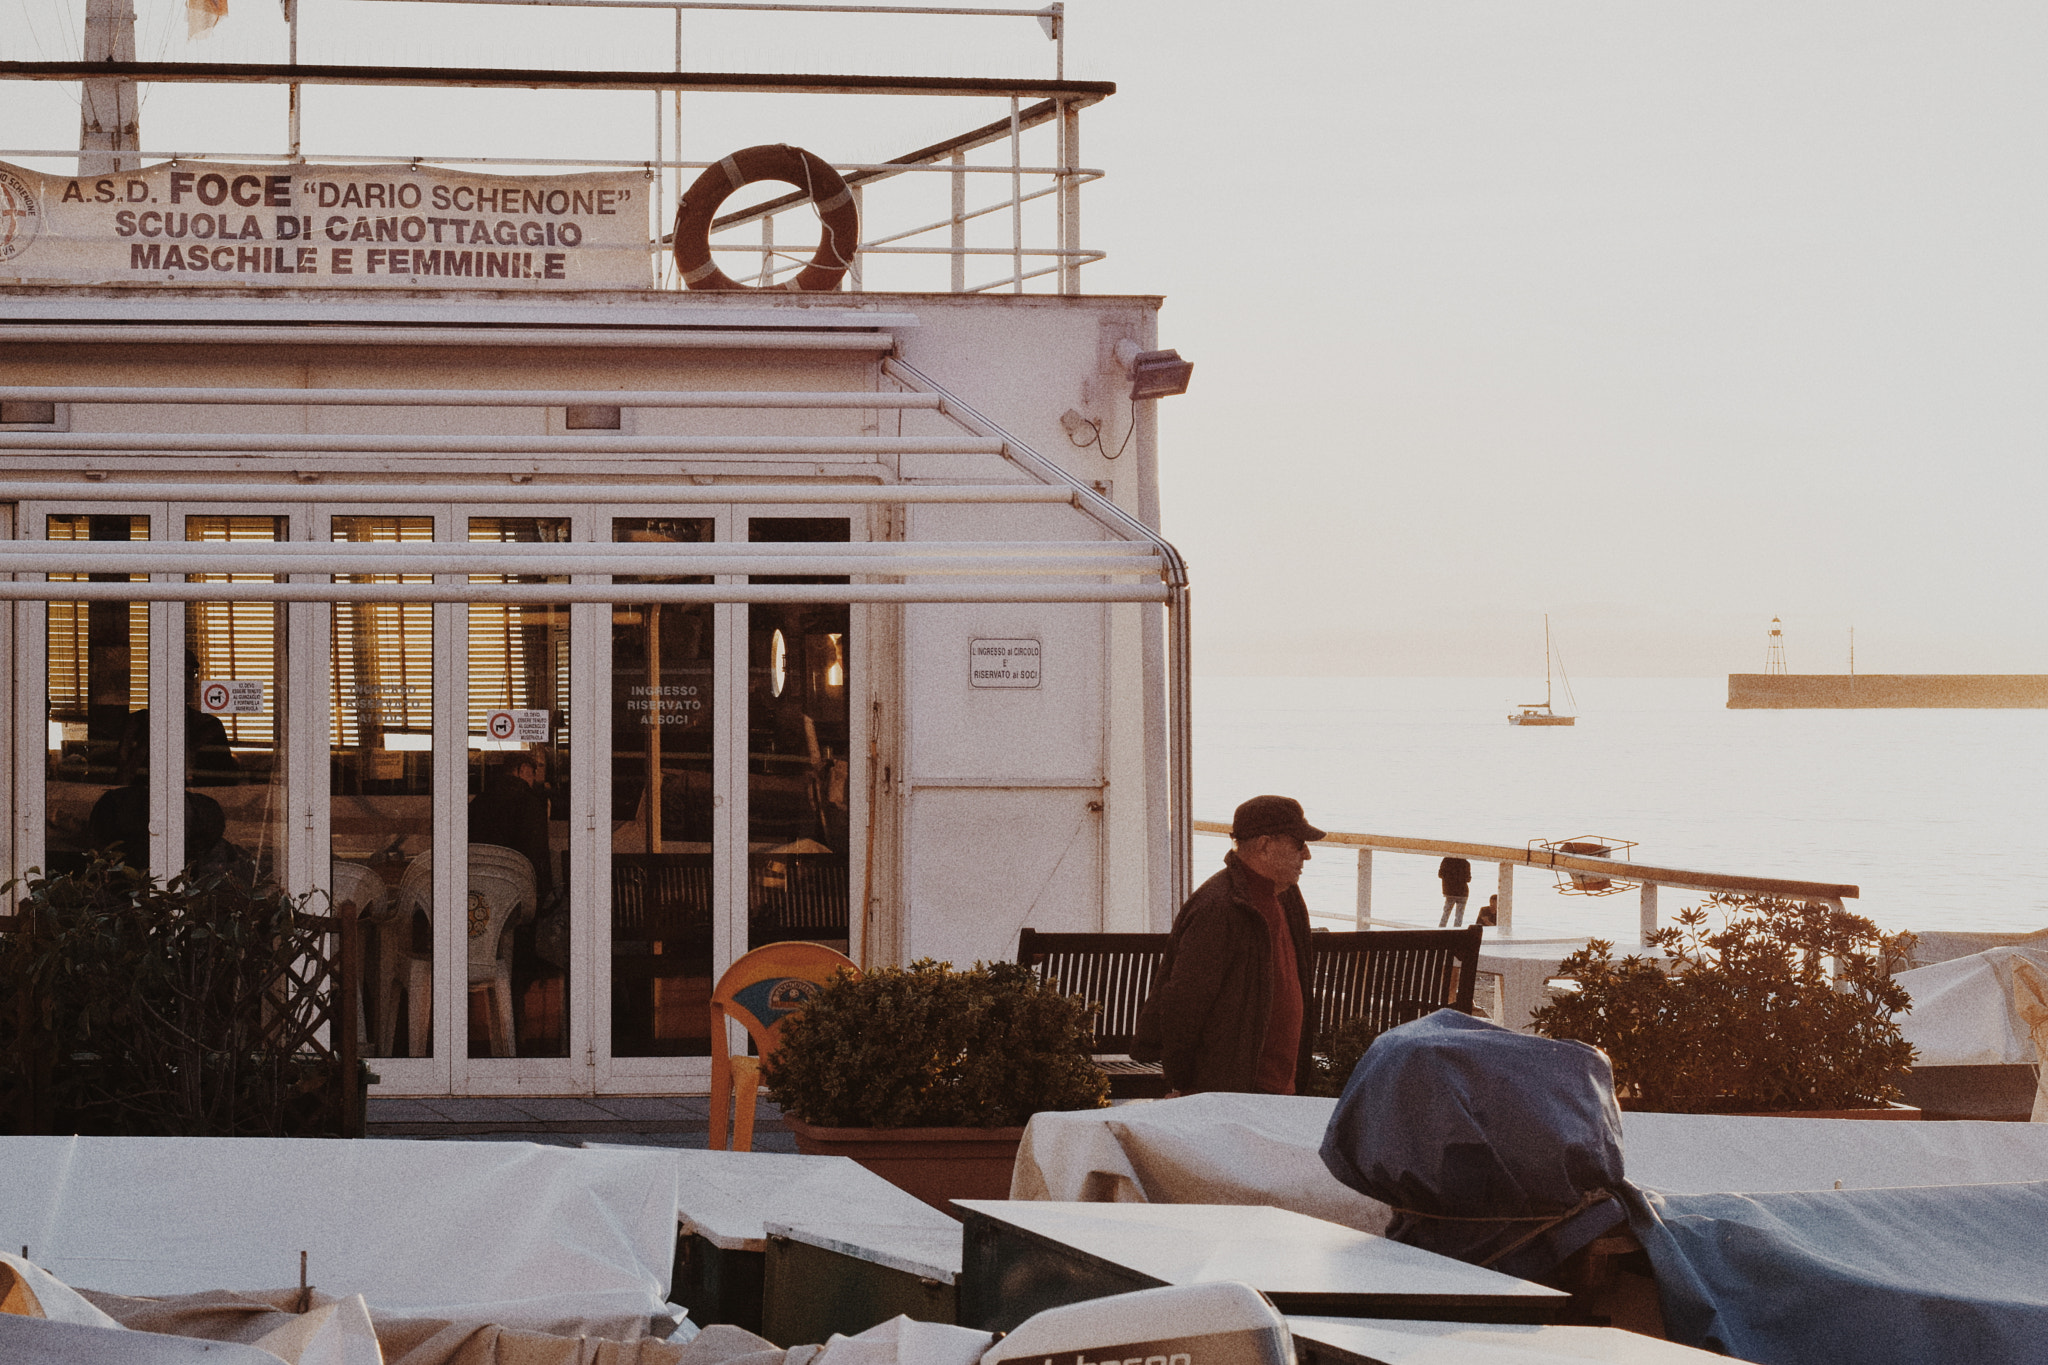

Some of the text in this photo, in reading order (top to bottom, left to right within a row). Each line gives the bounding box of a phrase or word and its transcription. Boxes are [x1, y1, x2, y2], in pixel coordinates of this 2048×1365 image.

[61, 179, 157, 203] A.S.D.
[170, 172, 291, 207] FOCE
[9, 177, 36, 216] SCHENONE
[115, 210, 582, 247] SCUOLA DI CANOTTAGGIO
[130, 243, 566, 279] MASCHILE E FEMMINILE
[1014, 647, 1039, 656] CIRCOLO
[974, 670, 1010, 679] RISERVATO
[1021, 670, 1038, 679] SOCI
[631, 686, 697, 696] INGRESSO
[627, 700, 701, 710] RISERVATO
[657, 715, 688, 725] SOCI
